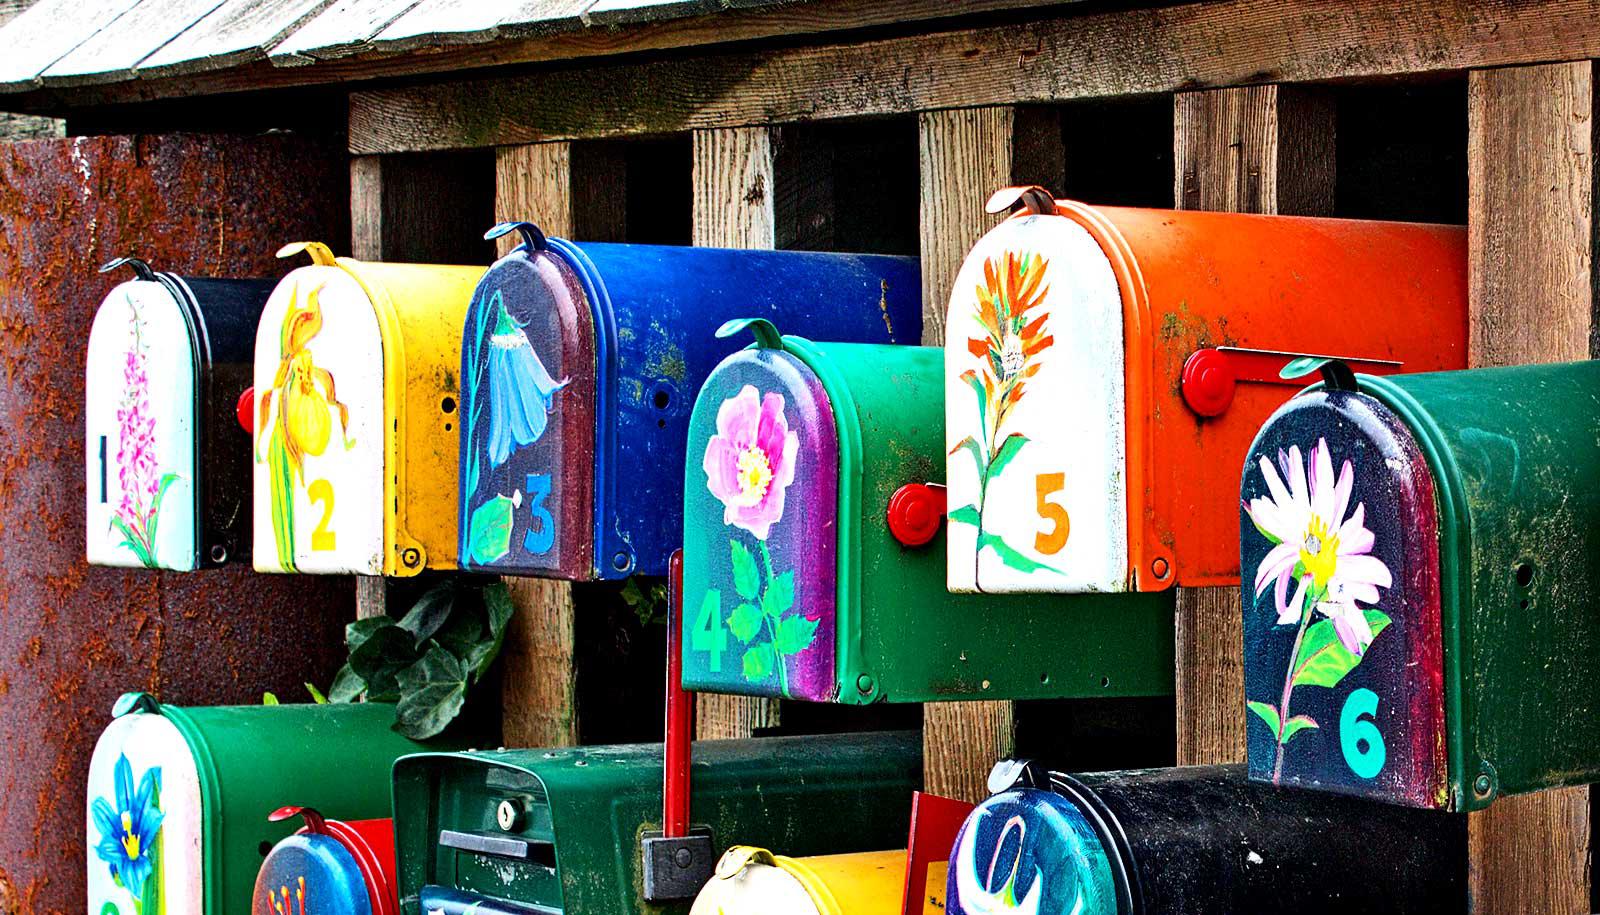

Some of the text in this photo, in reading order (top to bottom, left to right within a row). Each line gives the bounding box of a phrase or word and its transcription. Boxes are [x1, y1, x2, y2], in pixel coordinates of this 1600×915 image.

[99, 435, 107, 503] 1
[307, 479, 336, 551] 2
[523, 473, 555, 555] 3
[1034, 472, 1070, 555] 5
[691, 588, 727, 673] 4
[1339, 687, 1386, 778] 6
